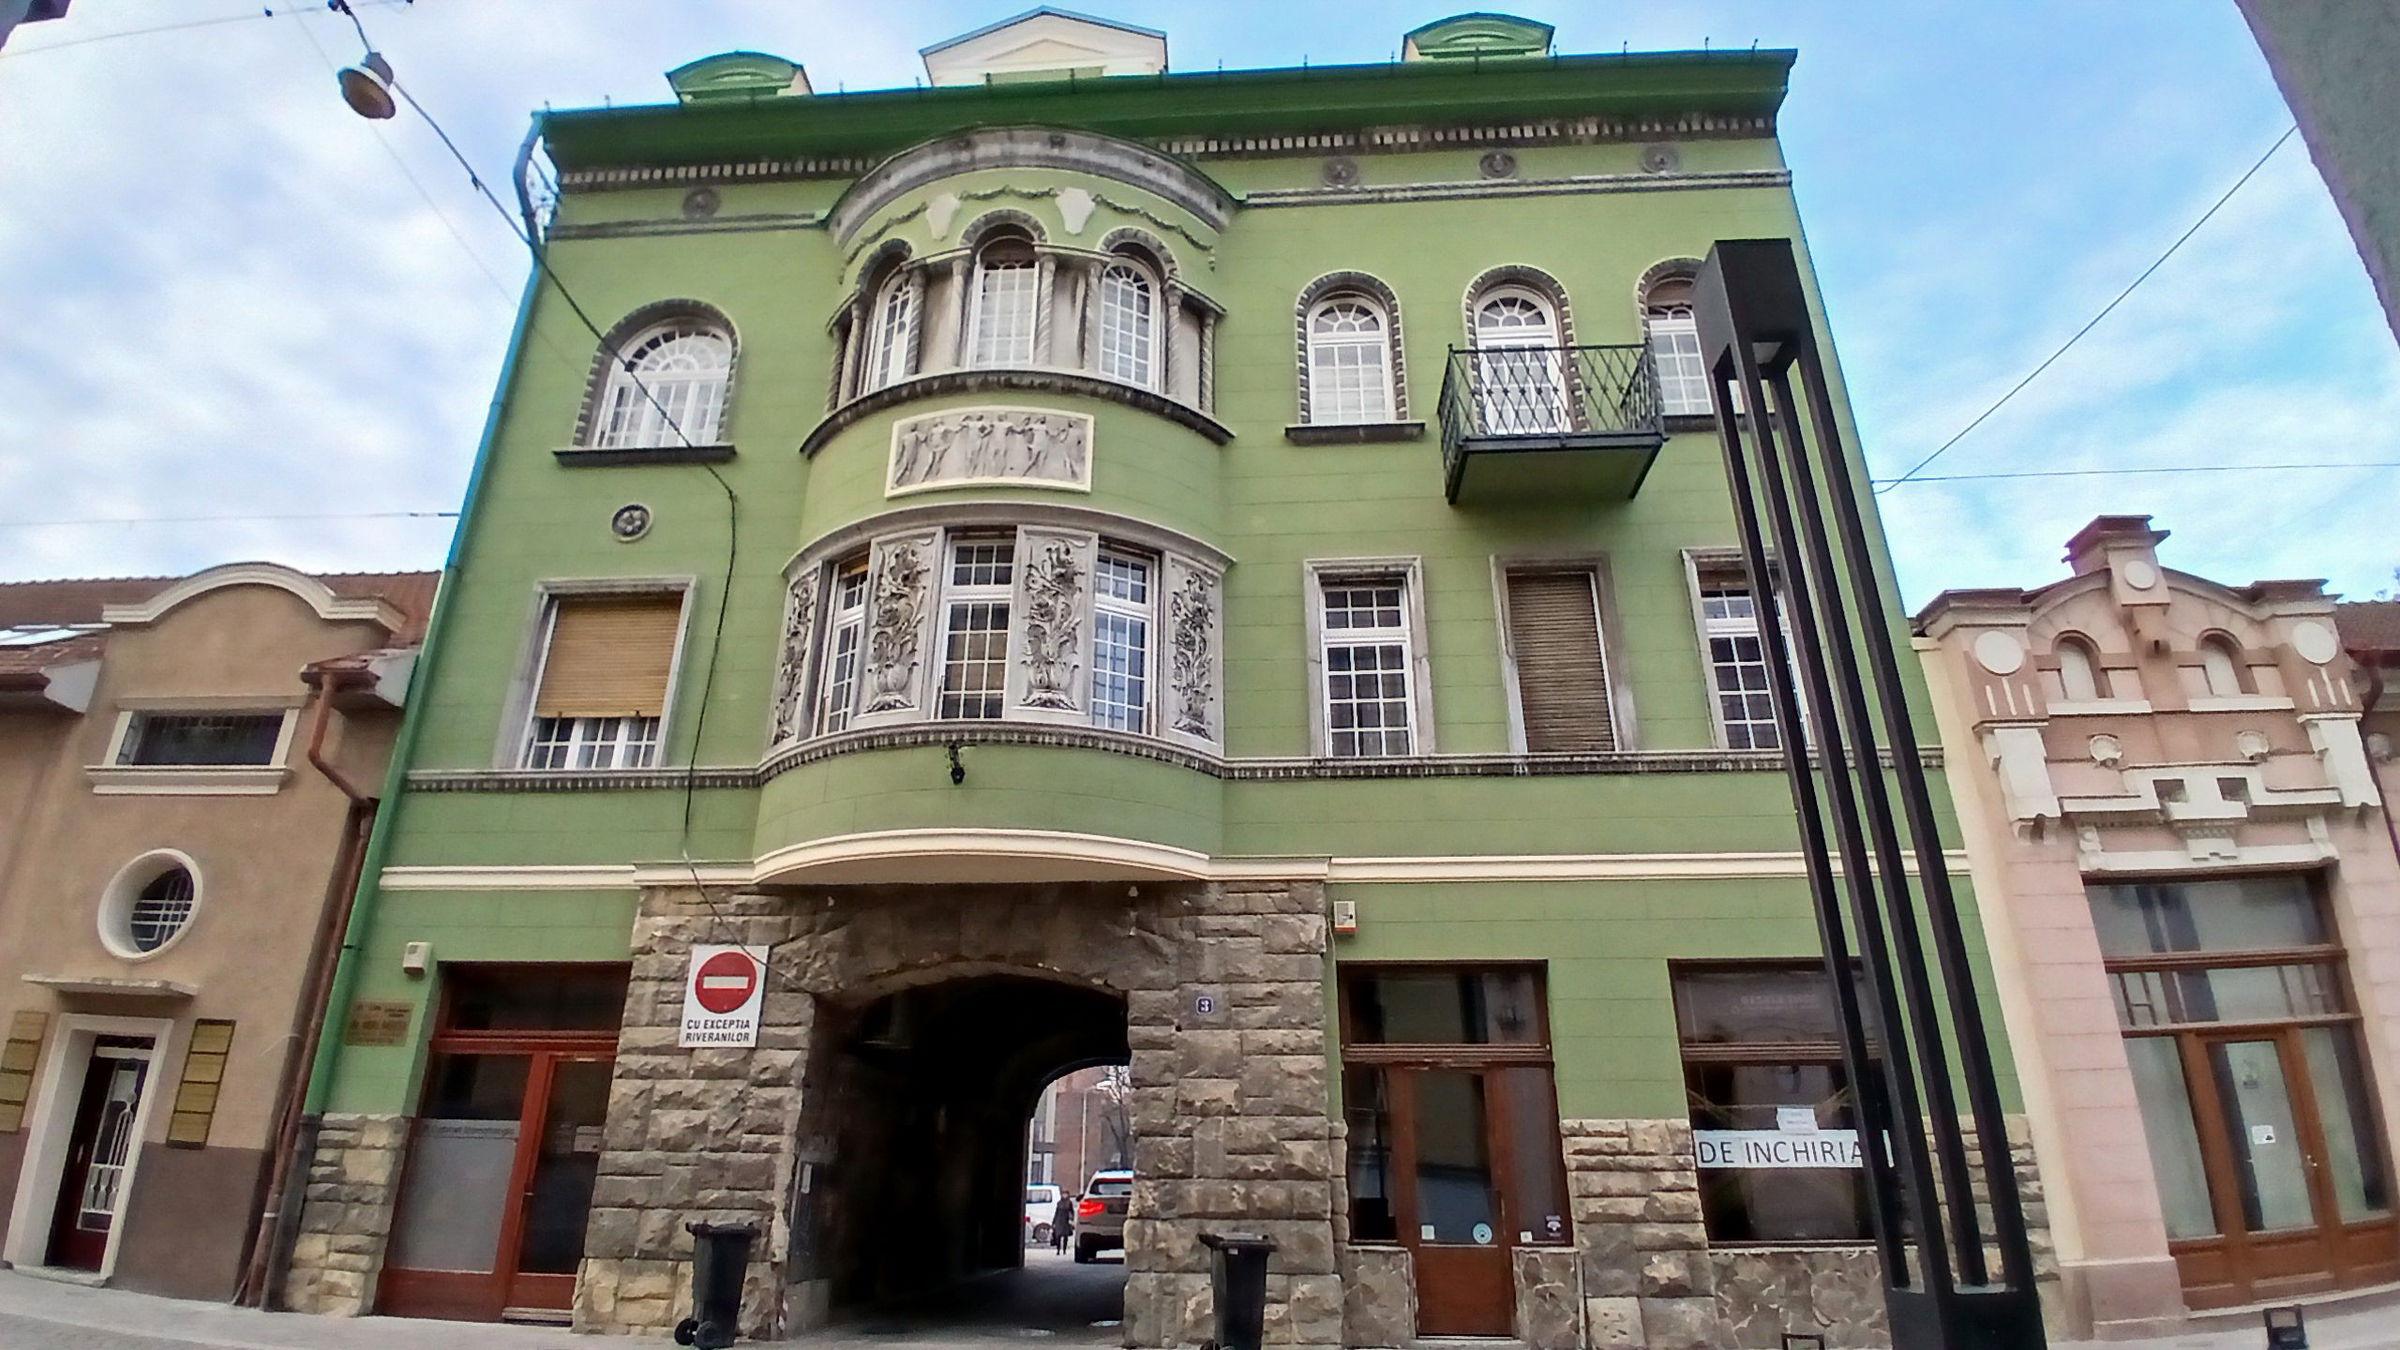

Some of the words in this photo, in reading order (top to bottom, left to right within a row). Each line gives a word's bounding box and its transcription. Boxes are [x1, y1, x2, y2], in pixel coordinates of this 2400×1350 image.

[686, 1019, 701, 1030] CU
[703, 1019, 751, 1030] EXCEPTIA
[685, 1032, 750, 1042] RIVERANILOR
[1698, 1141, 1735, 1164] DE
[1745, 1140, 1865, 1164] INCHIRIA
